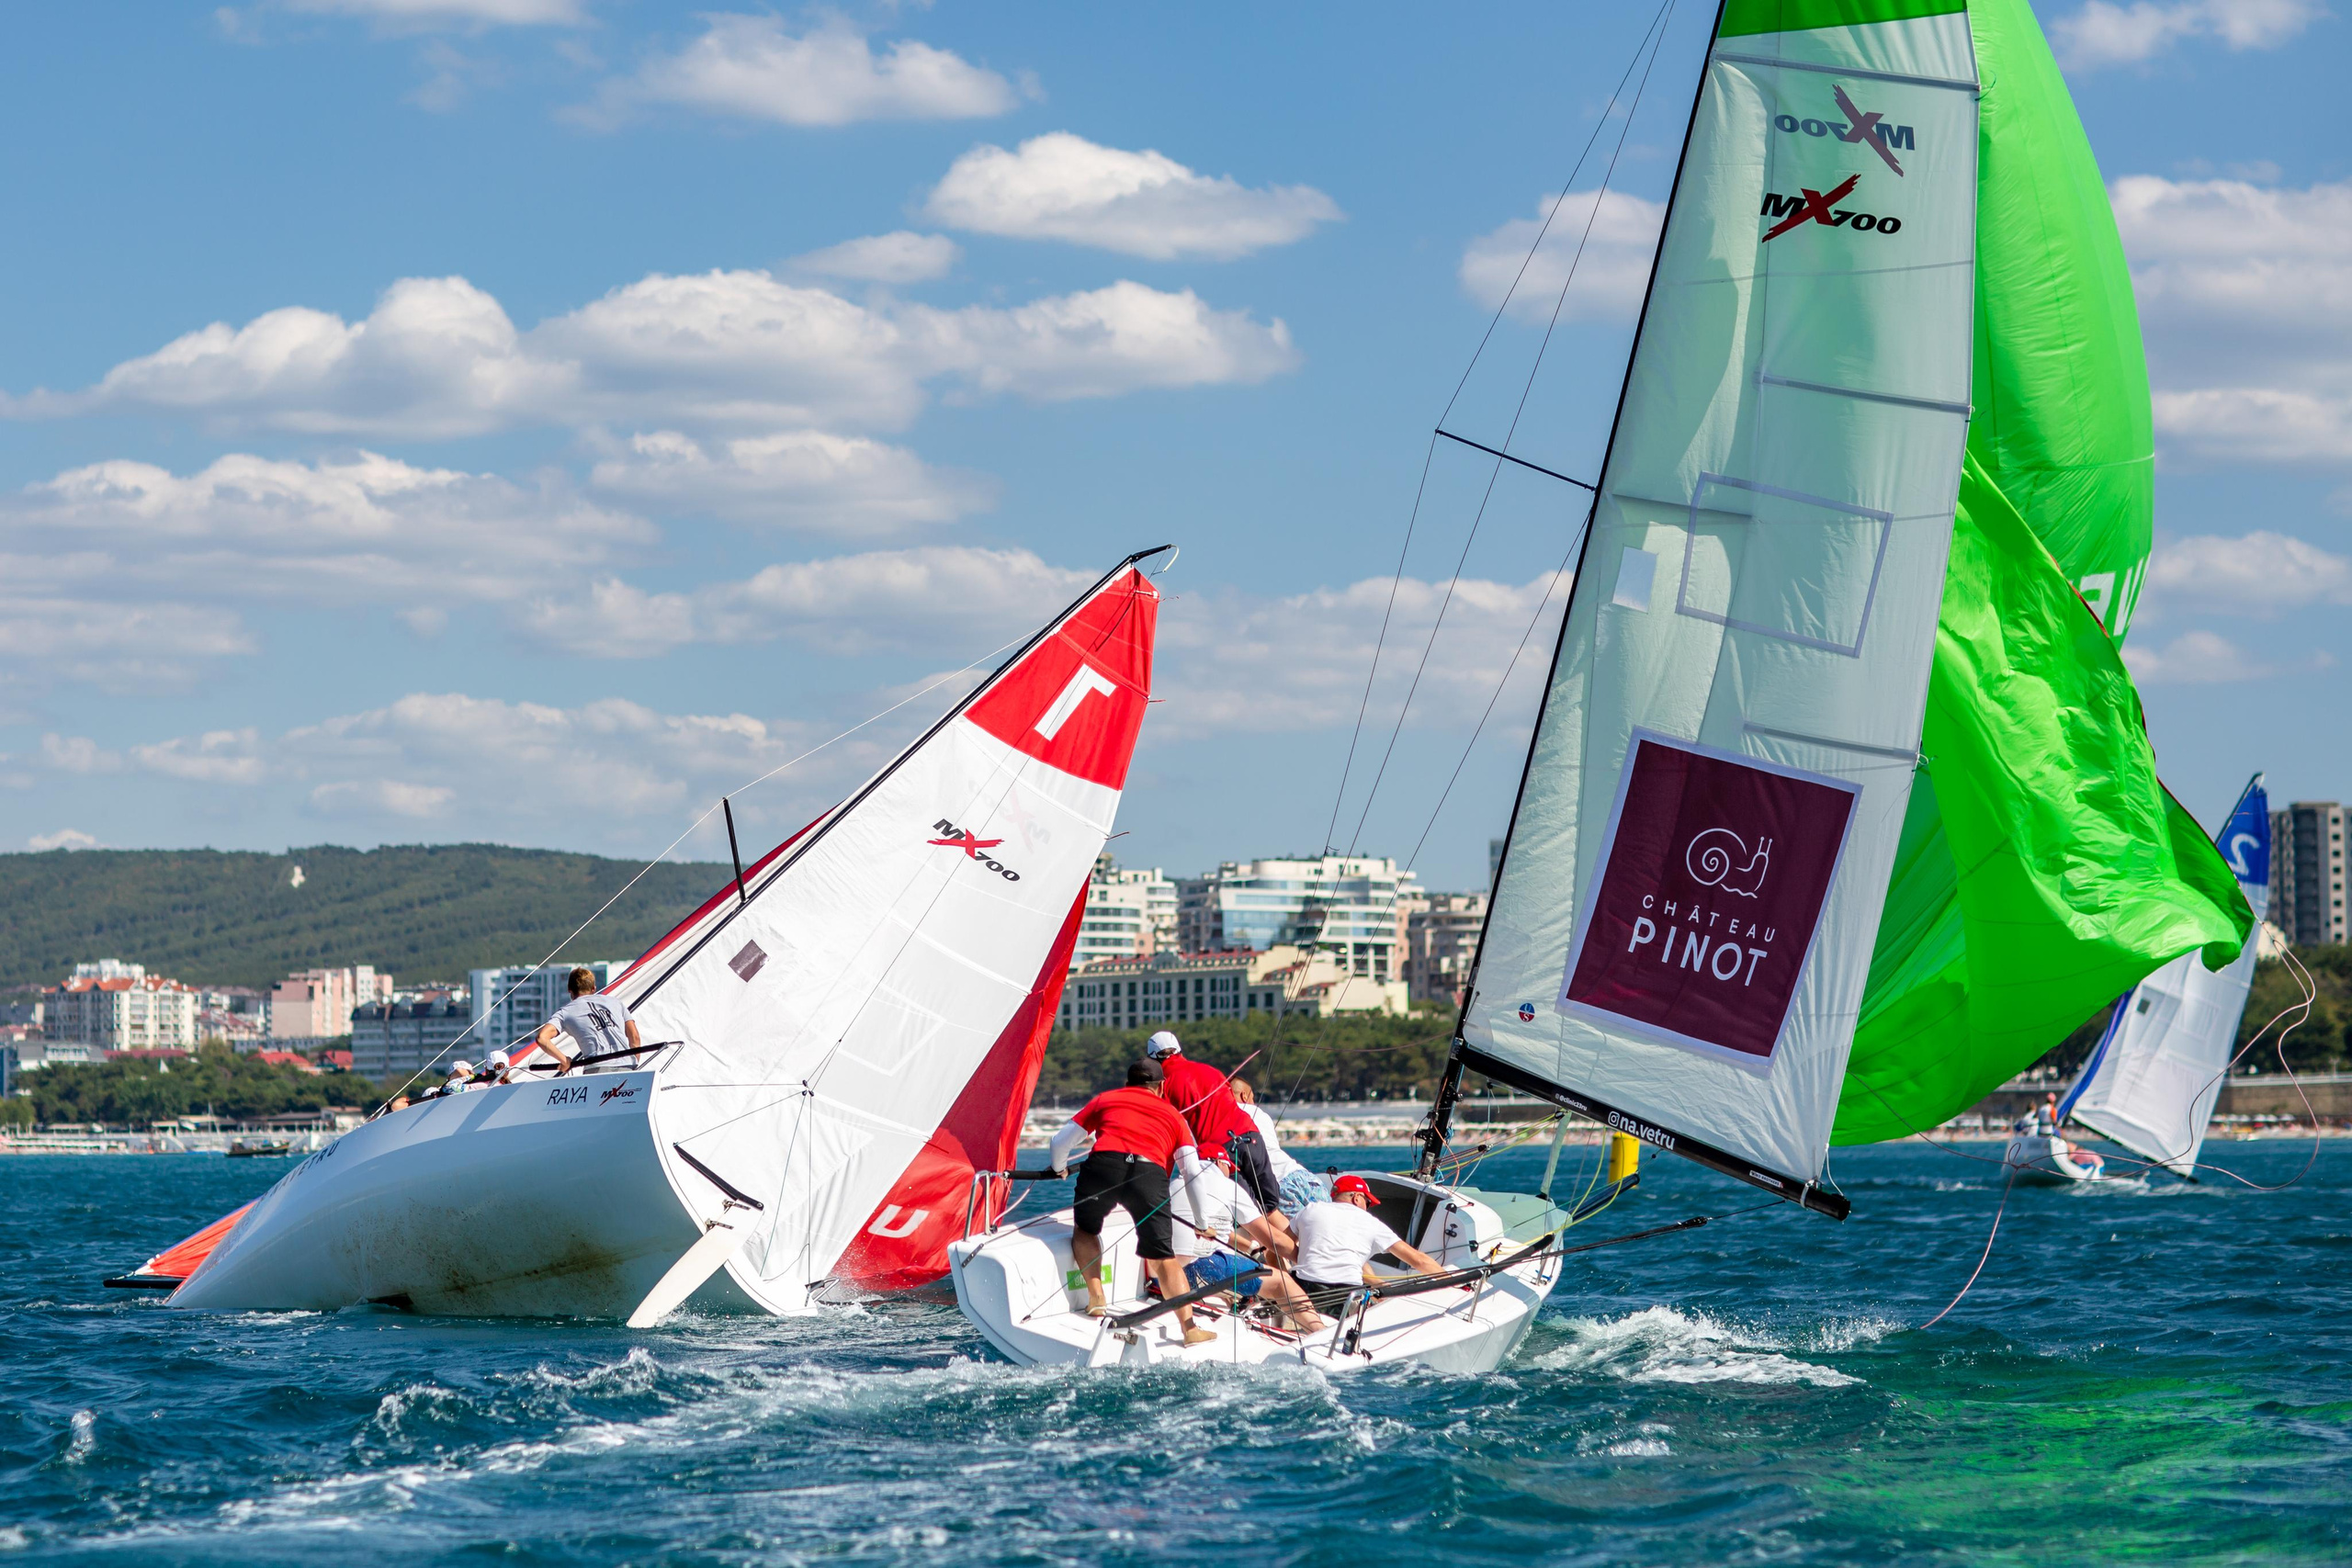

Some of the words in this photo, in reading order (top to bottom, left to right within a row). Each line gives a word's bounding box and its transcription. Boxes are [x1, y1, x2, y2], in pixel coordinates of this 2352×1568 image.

[1760, 174, 1902, 243] MX700
[927, 818, 1021, 882] MX700
[1642, 895, 1776, 942] CHÂTEAU
[1628, 916, 1768, 987] PINOT
[547, 1087, 588, 1106] RAYA
[599, 1078, 636, 1107] MX700
